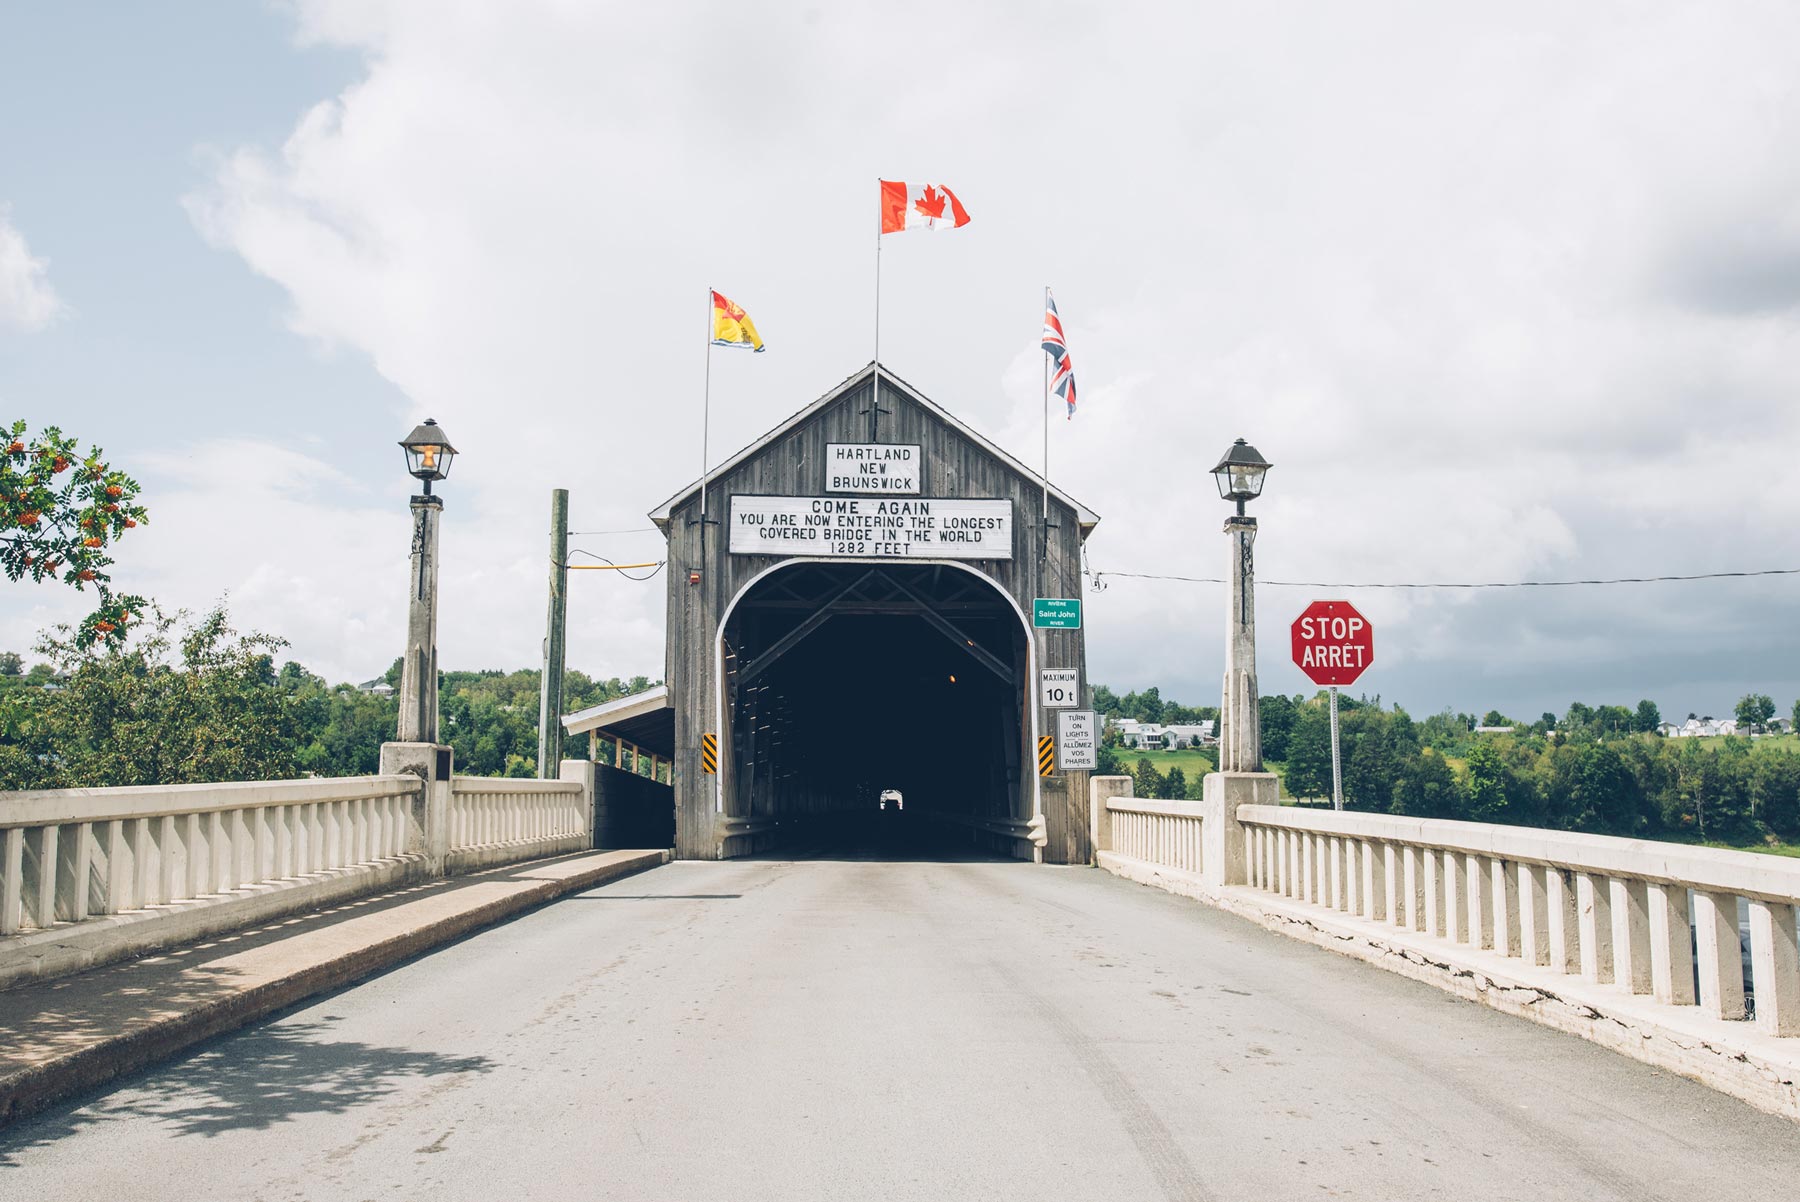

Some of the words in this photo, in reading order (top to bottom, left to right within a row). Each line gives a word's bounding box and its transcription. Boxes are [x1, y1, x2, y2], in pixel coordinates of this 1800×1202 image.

[836, 448, 911, 461] HARTLAND
[860, 463, 887, 474] NEW
[833, 477, 913, 489] BRUNSWICK
[812, 501, 859, 514] COME
[878, 502, 930, 515] AGAIN
[740, 514, 764, 525] YOU
[772, 514, 797, 525] ARE
[804, 515, 830, 526] NOW
[838, 517, 904, 528] ENTERING
[910, 517, 935, 528] THE
[943, 518, 1003, 529] LONGEST
[760, 528, 816, 539] COVERED
[824, 529, 872, 540] BRIDGE
[882, 530, 896, 540] IN
[906, 530, 931, 541] THE
[939, 531, 982, 542] WORLD
[831, 543, 865, 554] 1282
[875, 543, 910, 555] FEET
[1300, 617, 1364, 640] STOP
[1302, 643, 1365, 668] ARRÊT
[1046, 689, 1064, 701] 10
[1068, 691, 1074, 702] t
